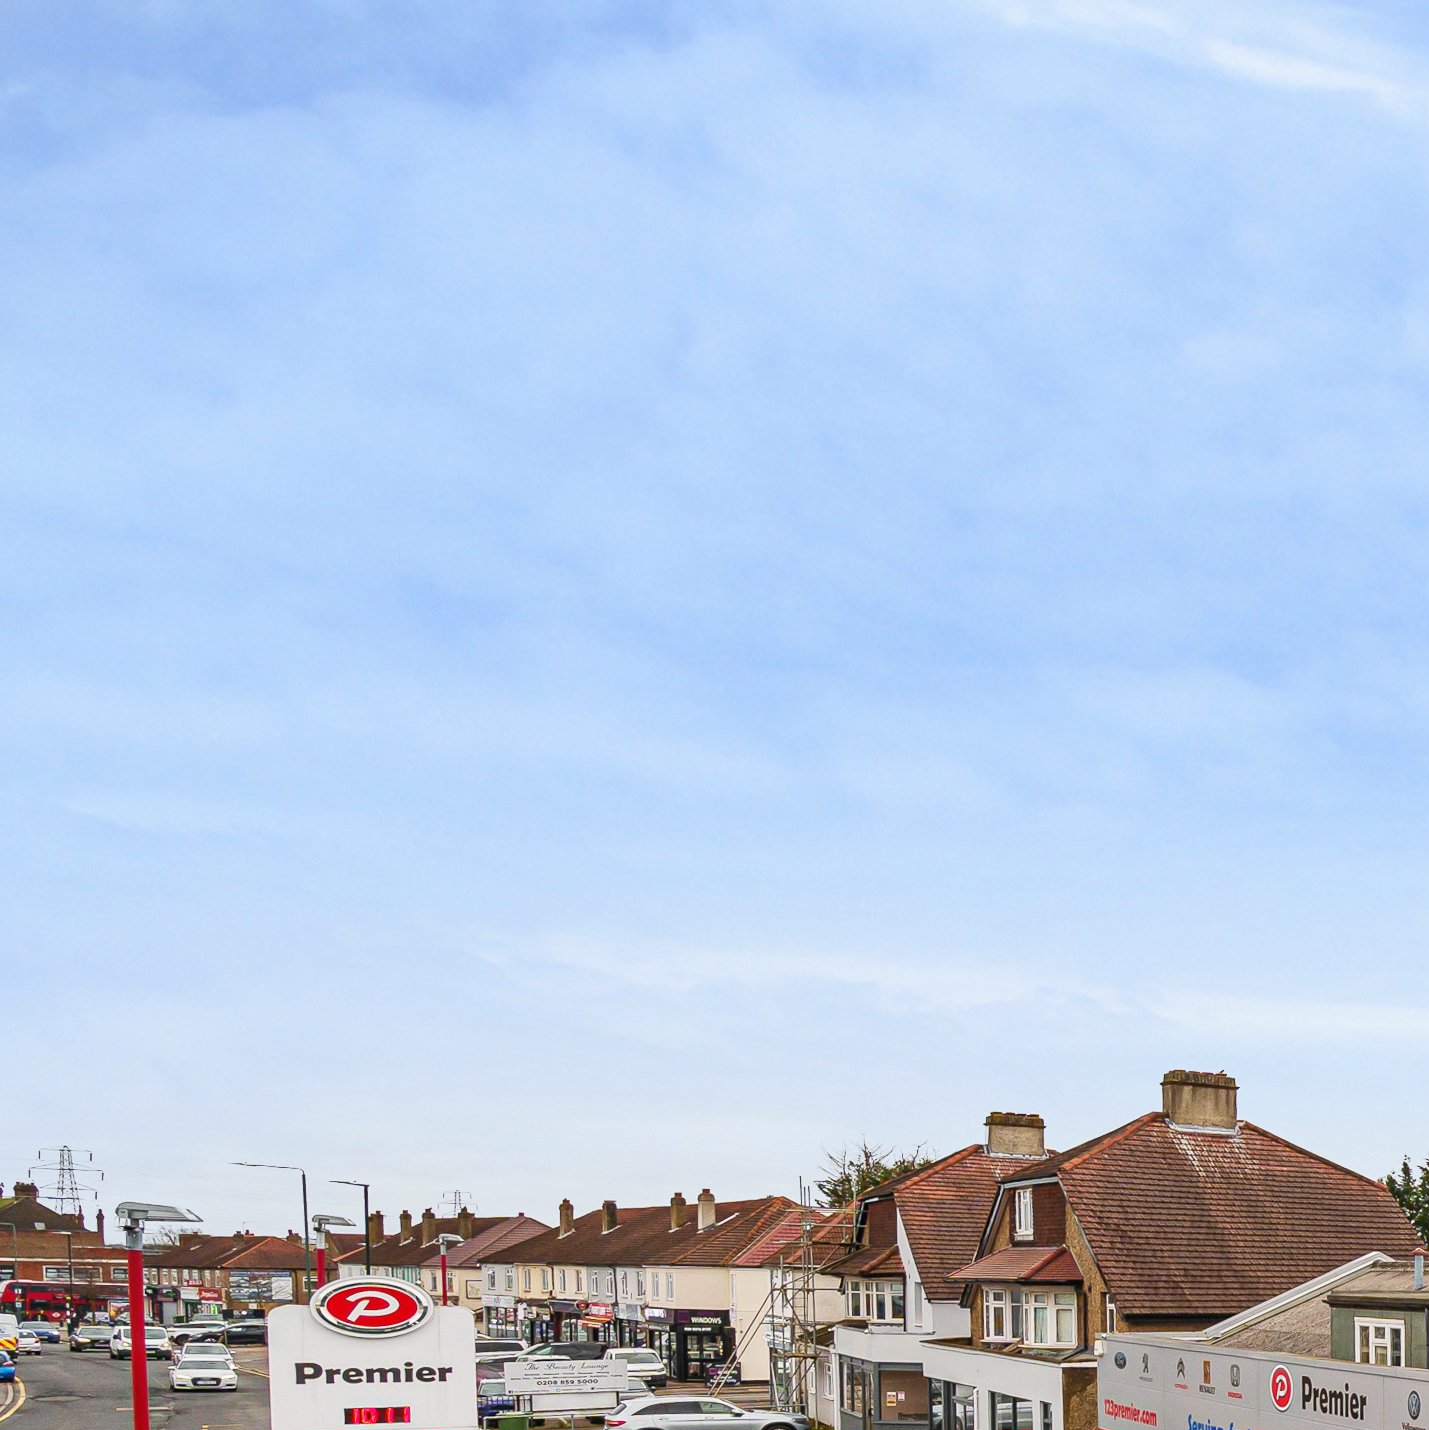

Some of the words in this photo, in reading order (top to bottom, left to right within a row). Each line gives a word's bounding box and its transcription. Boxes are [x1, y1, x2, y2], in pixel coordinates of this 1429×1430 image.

[691, 1316, 721, 1324] WINDOWS
[294, 1361, 453, 1385] Premier
[544, 1363, 575, 1371] Beauty
[580, 1362, 609, 1371] Lounge
[1301, 1375, 1367, 1421] Premier
[1104, 1398, 1157, 1427] 123premier.com
